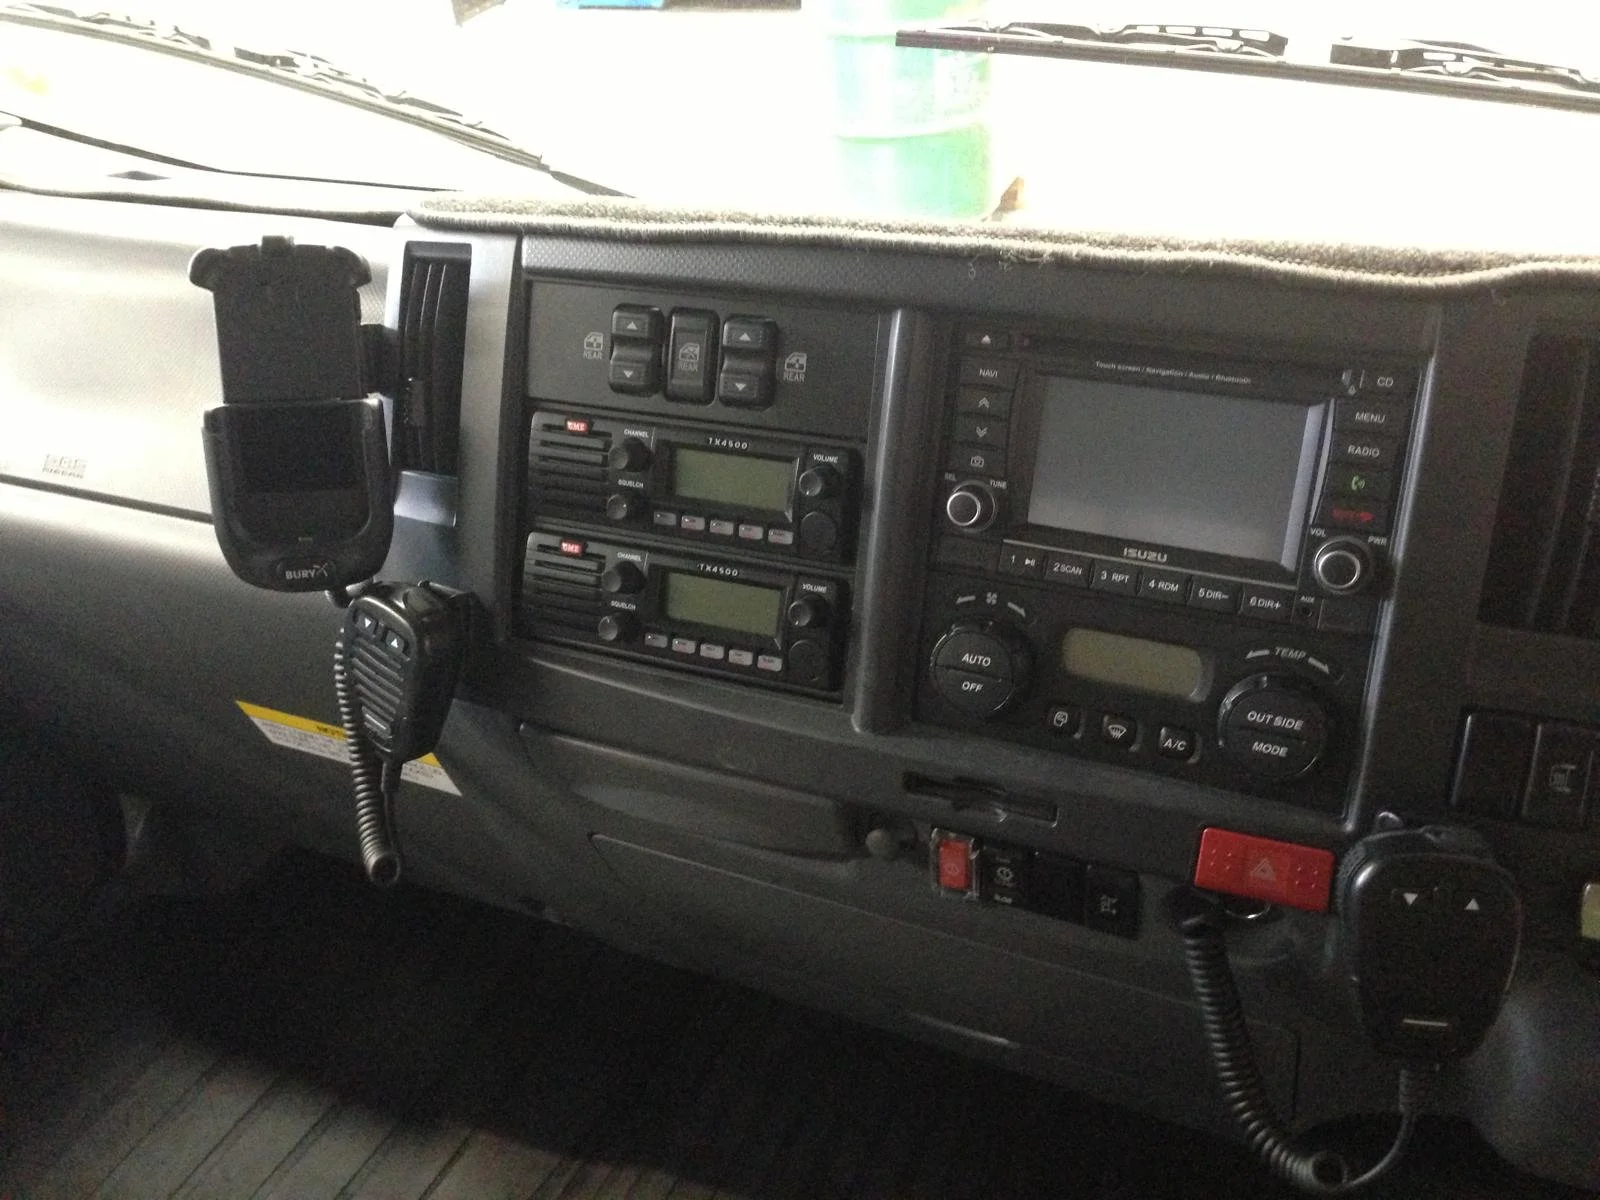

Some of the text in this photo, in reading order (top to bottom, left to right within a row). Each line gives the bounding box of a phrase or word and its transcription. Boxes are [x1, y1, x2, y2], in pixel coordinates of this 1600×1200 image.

[783, 371, 805, 382] REAR
[979, 368, 998, 378] NAVI
[1377, 376, 1394, 388] CD
[1355, 411, 1385, 424] MENU
[624, 428, 649, 438] CHANNEL
[1347, 444, 1380, 458] RADIO
[813, 454, 839, 463] VOLUME
[1309, 527, 1327, 538] VOL
[1367, 535, 1388, 547] PWR
[617, 552, 642, 562] CHANNEL
[1123, 546, 1168, 563] ISUZU
[285, 568, 316, 580] BURY
[1101, 571, 1130, 584] 3 RPT
[802, 583, 827, 593] VOLUME
[1158, 581, 1180, 593] RDM
[1274, 647, 1306, 660] TEMP
[961, 653, 991, 667] AUTO
[961, 681, 983, 693] OFF
[1164, 737, 1187, 752] A/C
[1251, 741, 1289, 758] MODE
